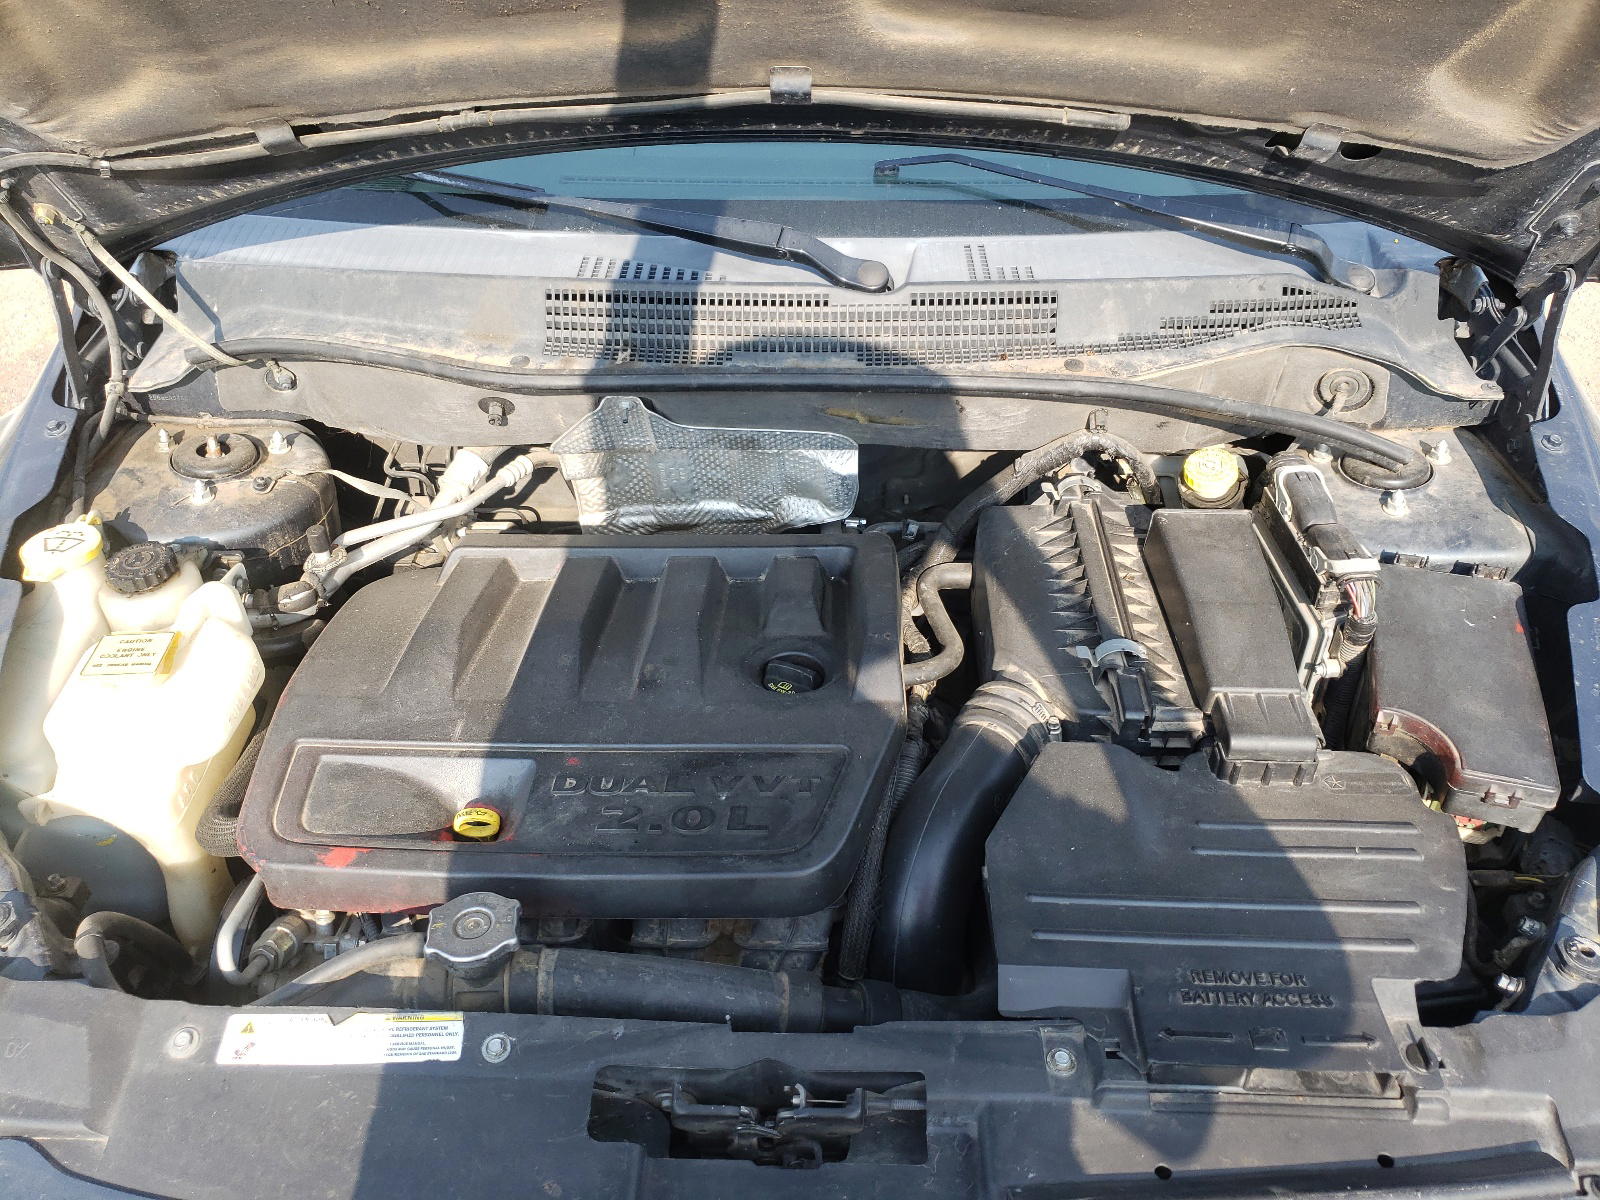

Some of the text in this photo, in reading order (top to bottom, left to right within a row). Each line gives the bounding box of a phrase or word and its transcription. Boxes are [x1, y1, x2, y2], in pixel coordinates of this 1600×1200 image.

[551, 775, 822, 797] DUAL VVT
[594, 805, 769, 834] 2.0L
[1189, 967, 1309, 988] REMOVE FOR
[1178, 988, 1337, 1009] BATTERY ACCESS
